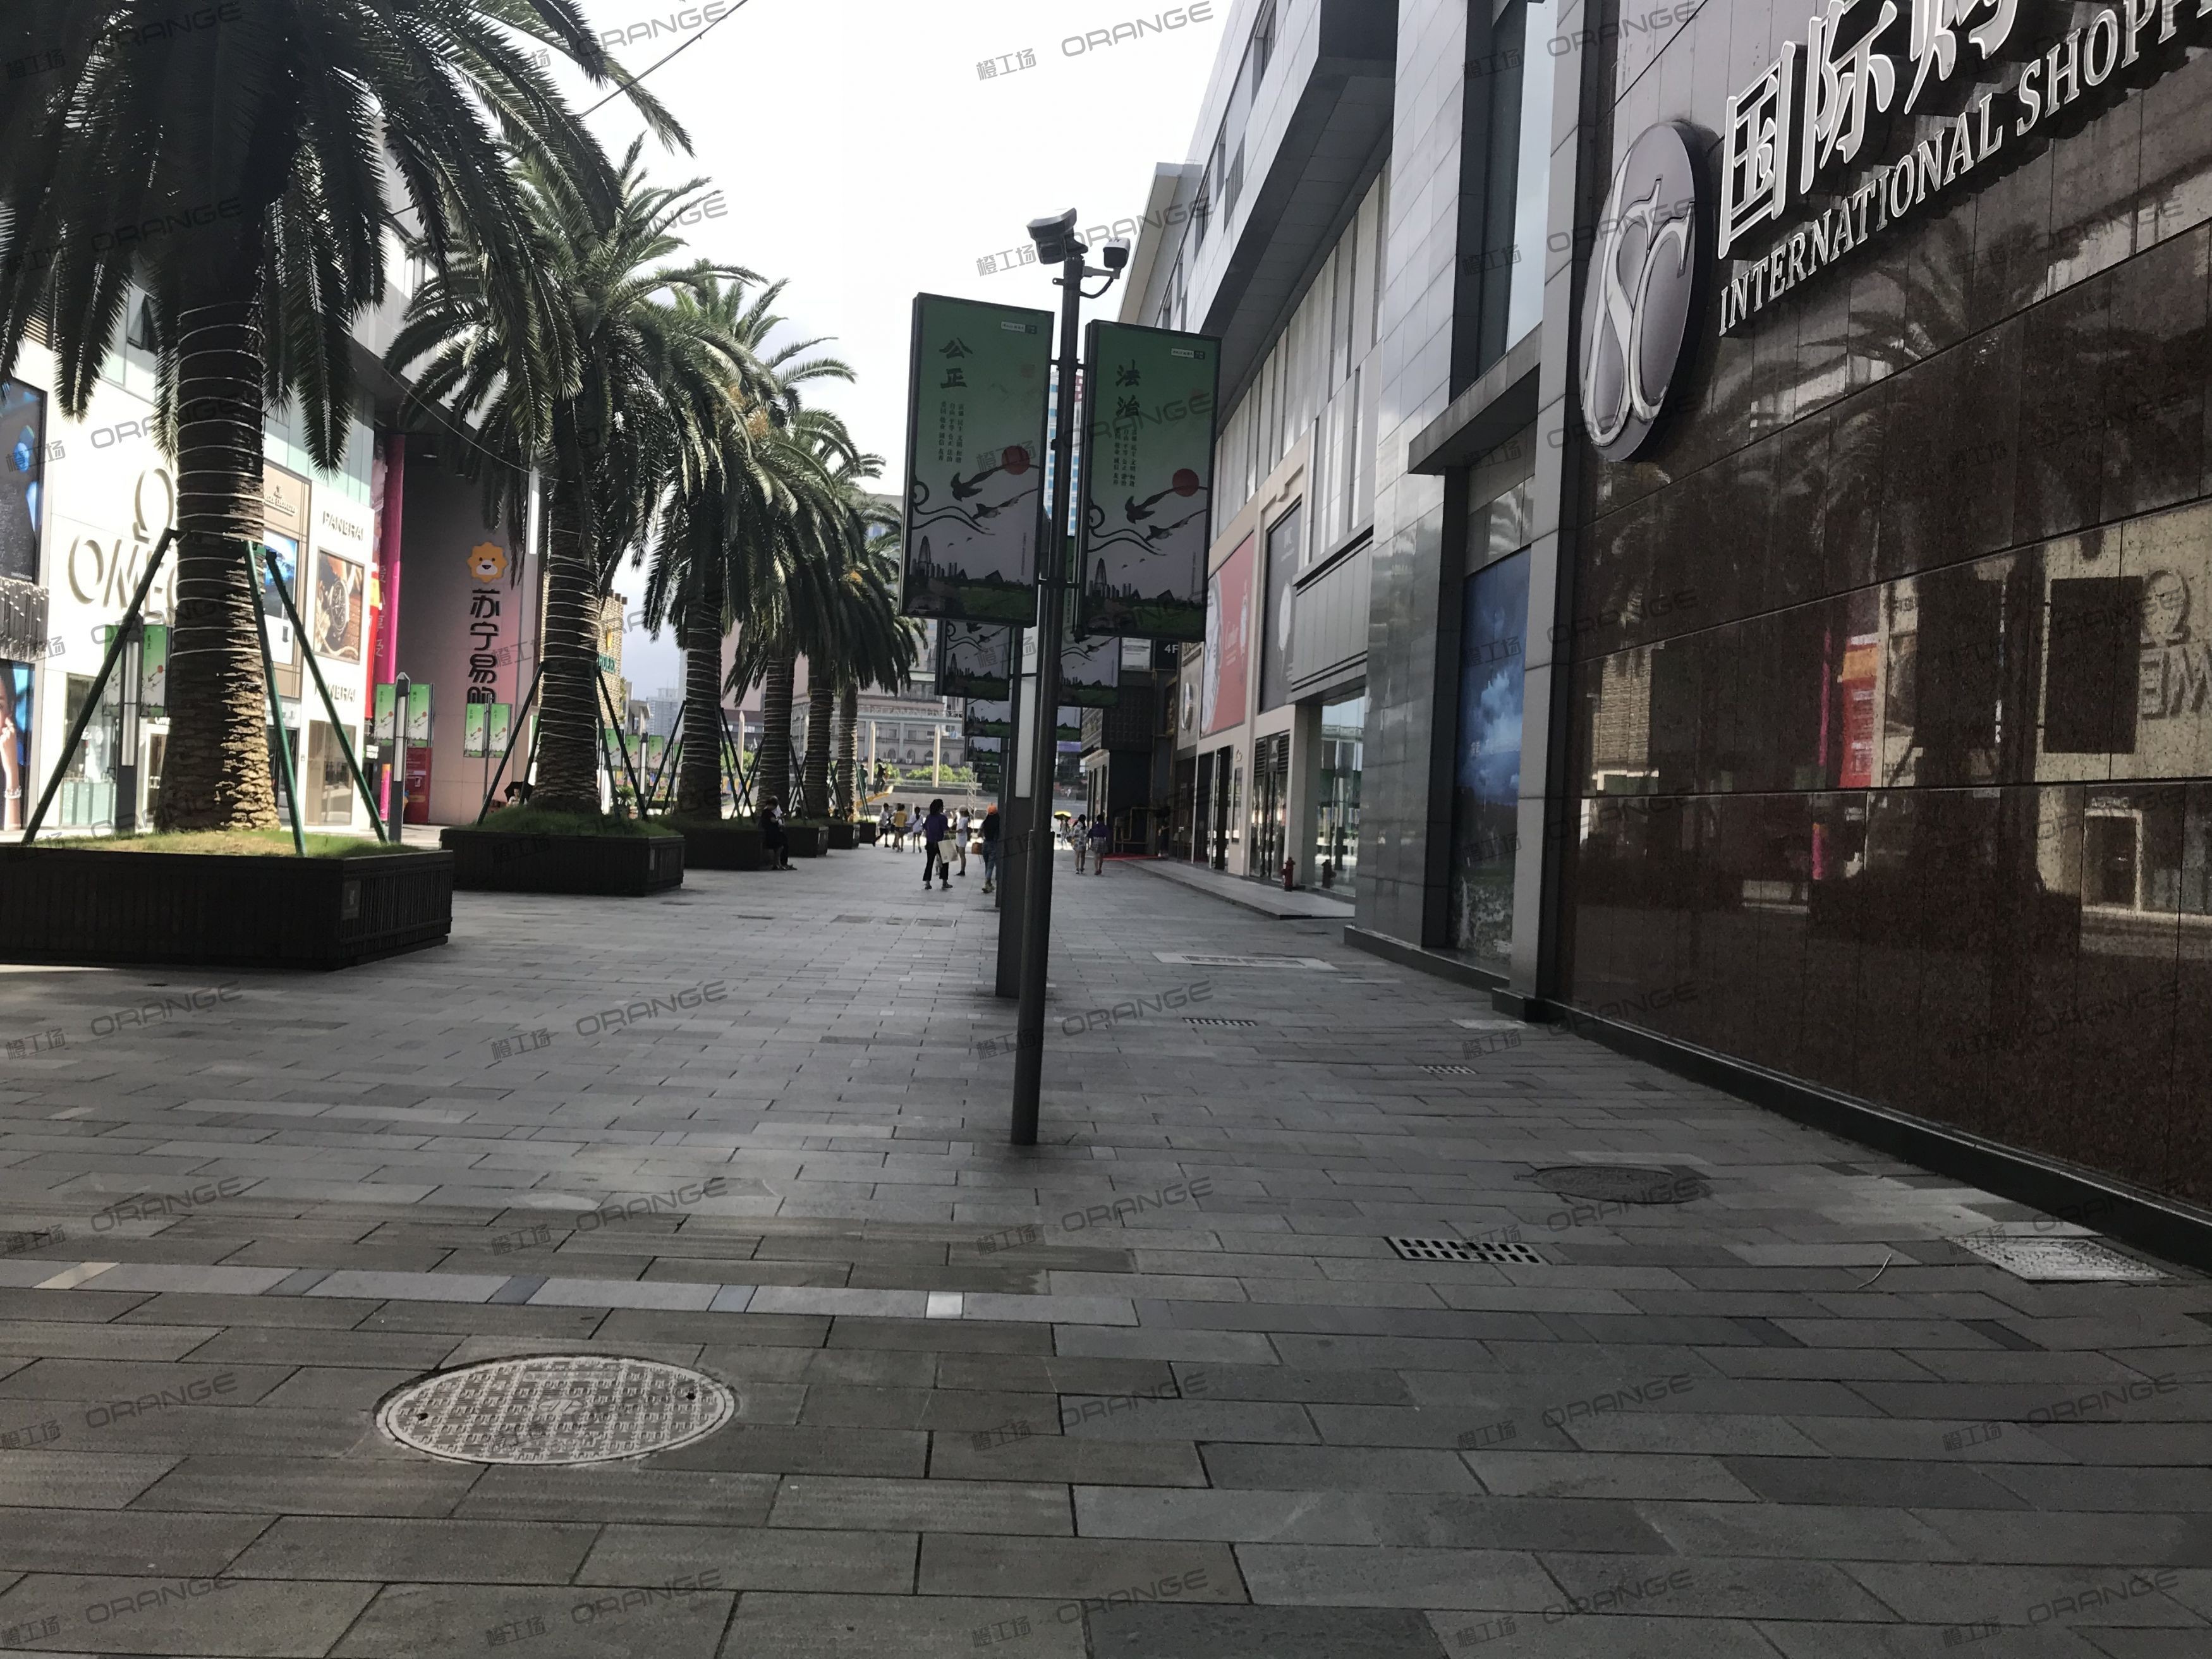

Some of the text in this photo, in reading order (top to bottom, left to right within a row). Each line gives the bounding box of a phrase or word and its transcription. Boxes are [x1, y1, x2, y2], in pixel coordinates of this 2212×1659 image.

[1718, 0, 2212, 337] INTERNATIONAL SHOPP
[939, 337, 974, 390] 公正
[1115, 358, 1141, 416] 法治
[322, 510, 364, 542] PANERAI
